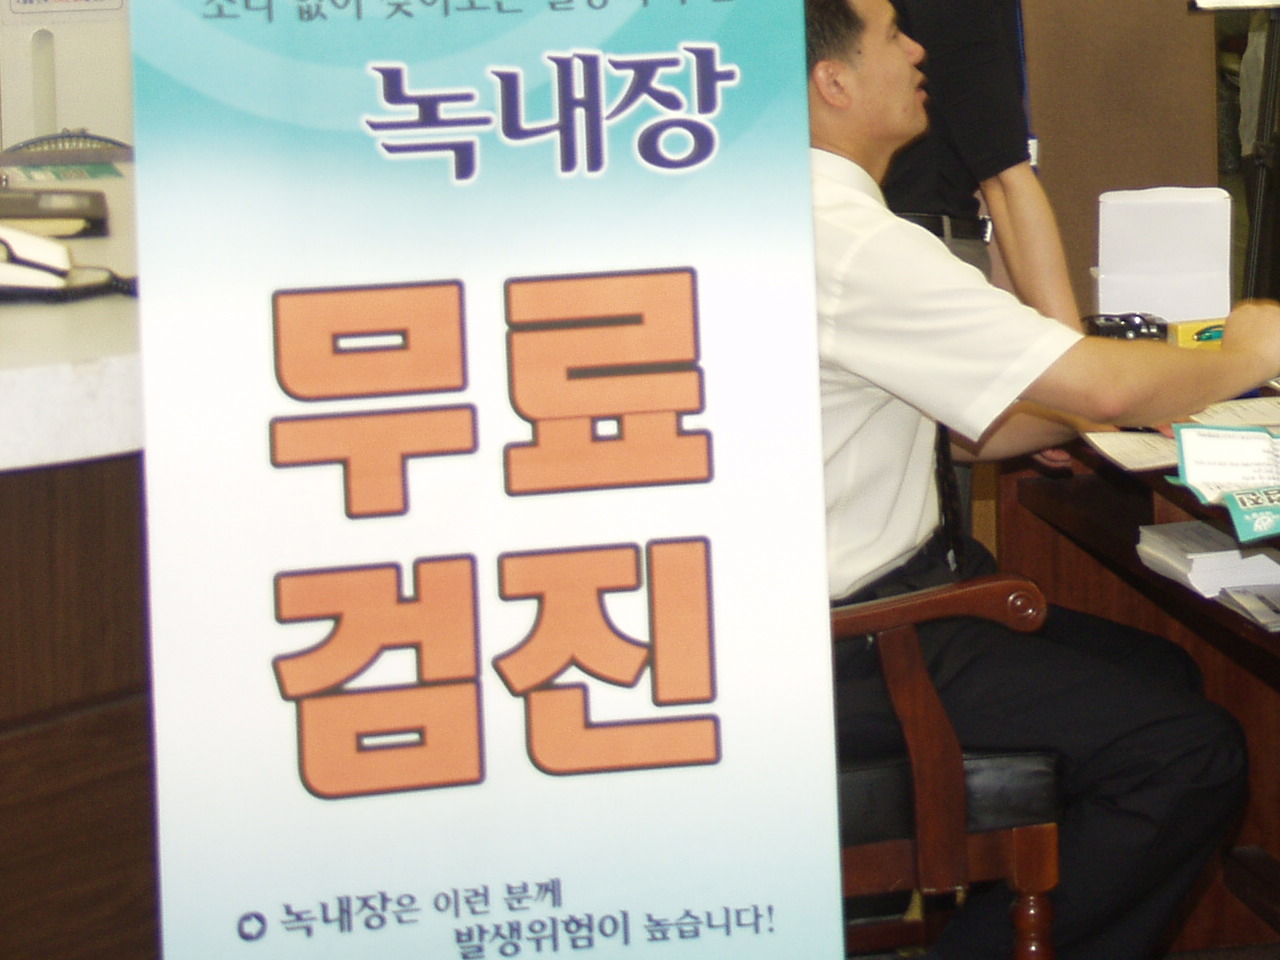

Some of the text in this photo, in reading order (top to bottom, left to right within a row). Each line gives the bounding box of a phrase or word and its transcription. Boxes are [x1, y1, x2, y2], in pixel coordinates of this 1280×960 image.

[363, 43, 740, 182] 녹내장
[269, 266, 714, 519] 무료
[271, 535, 722, 800] 검진
[279, 876, 563, 939] 녹내장은 이런 분께
[454, 903, 776, 960] 발생위험이 높습니다!
